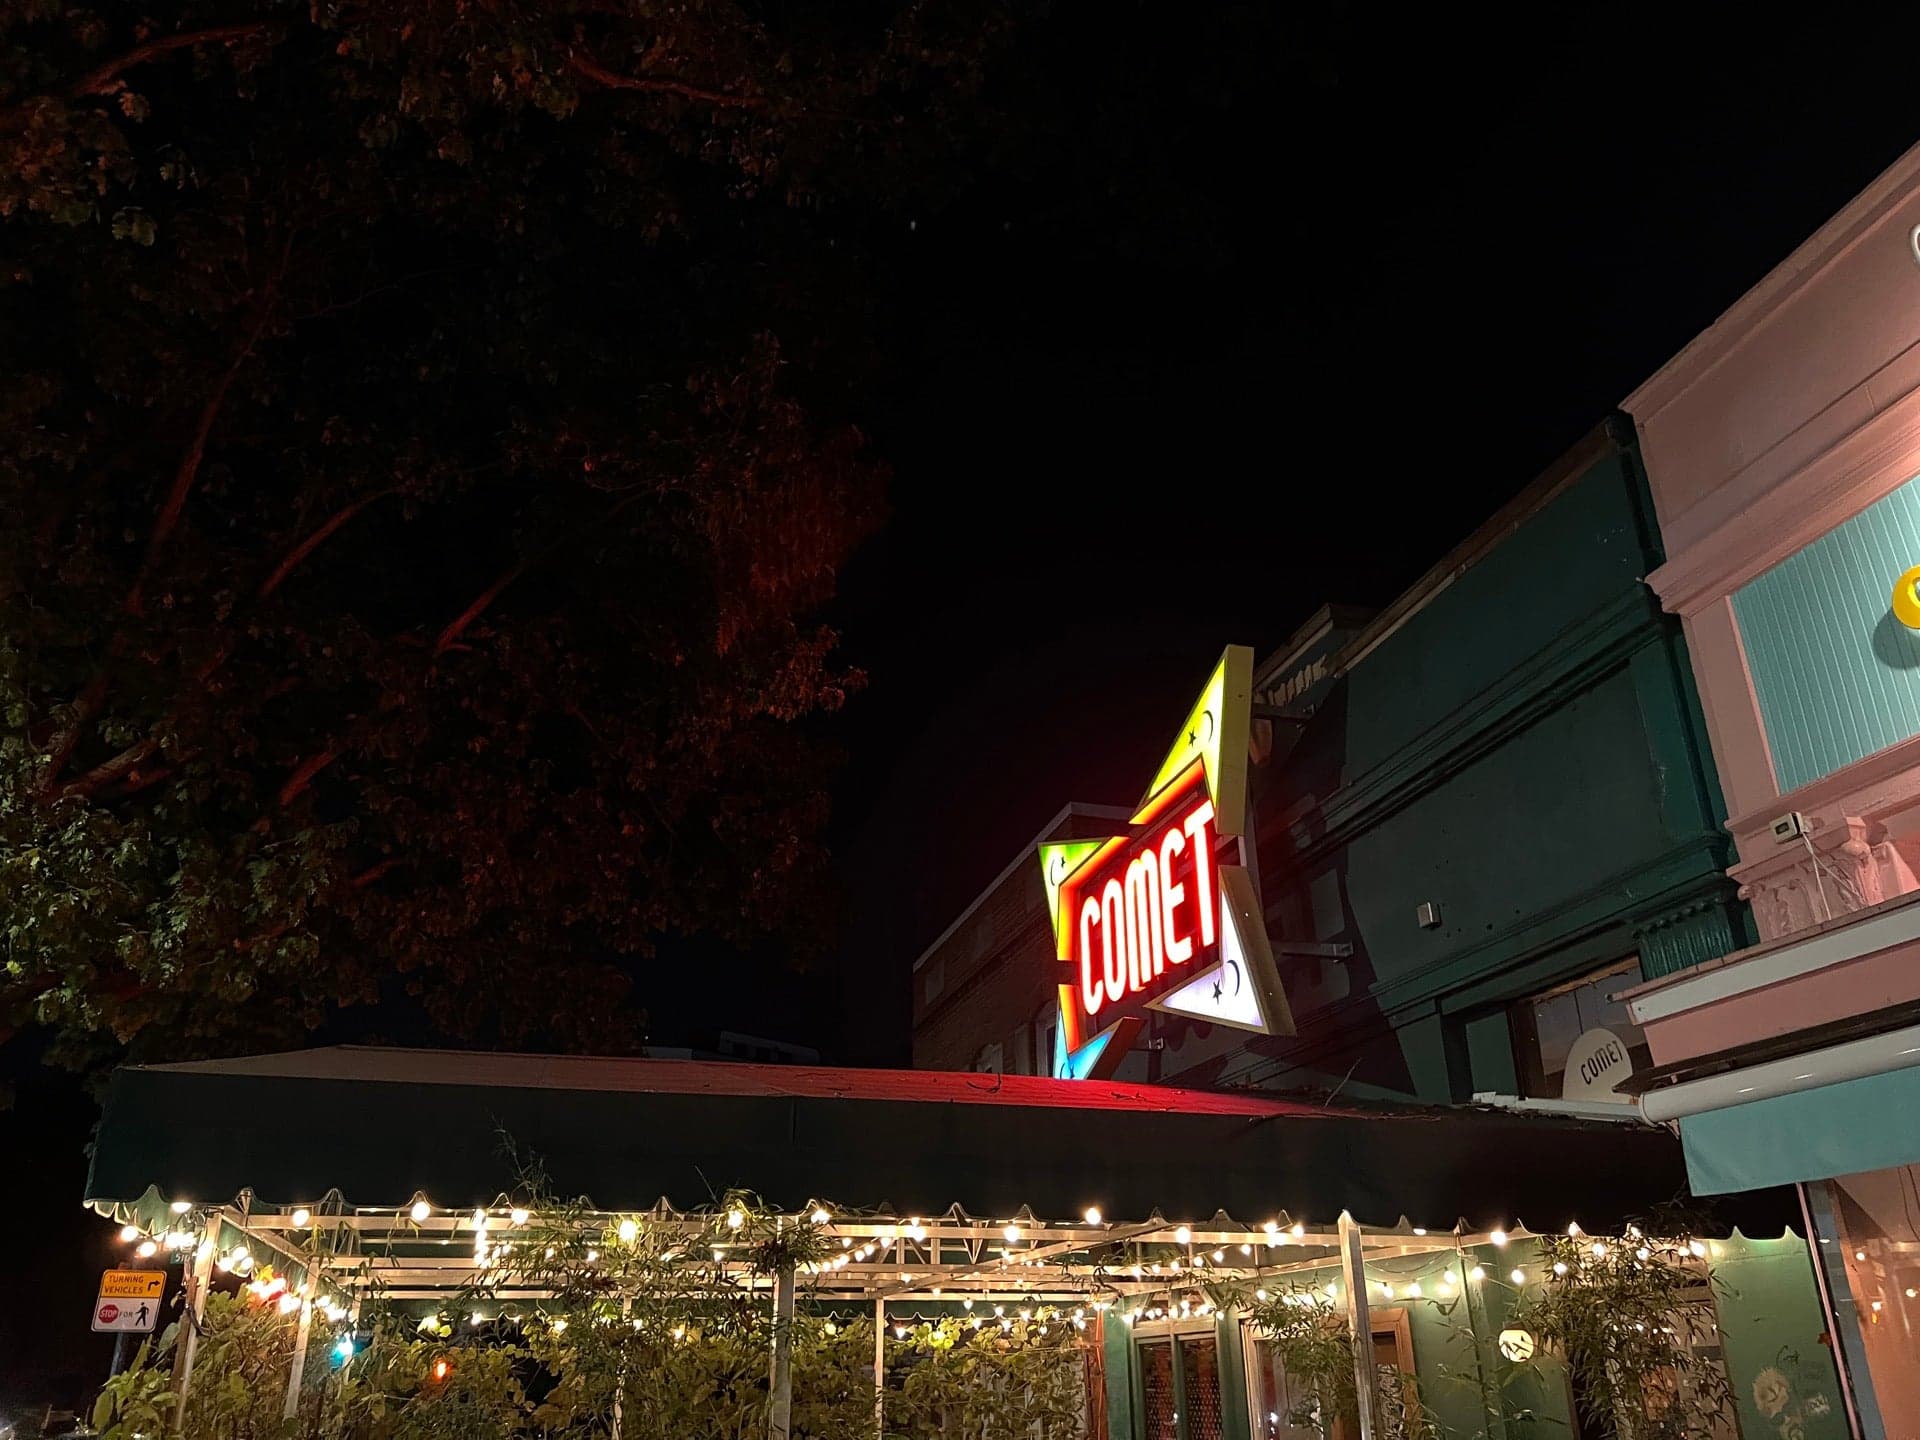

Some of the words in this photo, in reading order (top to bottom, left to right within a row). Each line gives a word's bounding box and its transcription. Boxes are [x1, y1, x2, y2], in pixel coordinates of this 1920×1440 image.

[1080, 799, 1215, 1015] COMET
[1581, 1041, 1623, 1085] COMET
[109, 1274, 144, 1283] TURNING
[104, 1285, 144, 1294] VEHICLES
[100, 1310, 118, 1318] STOP
